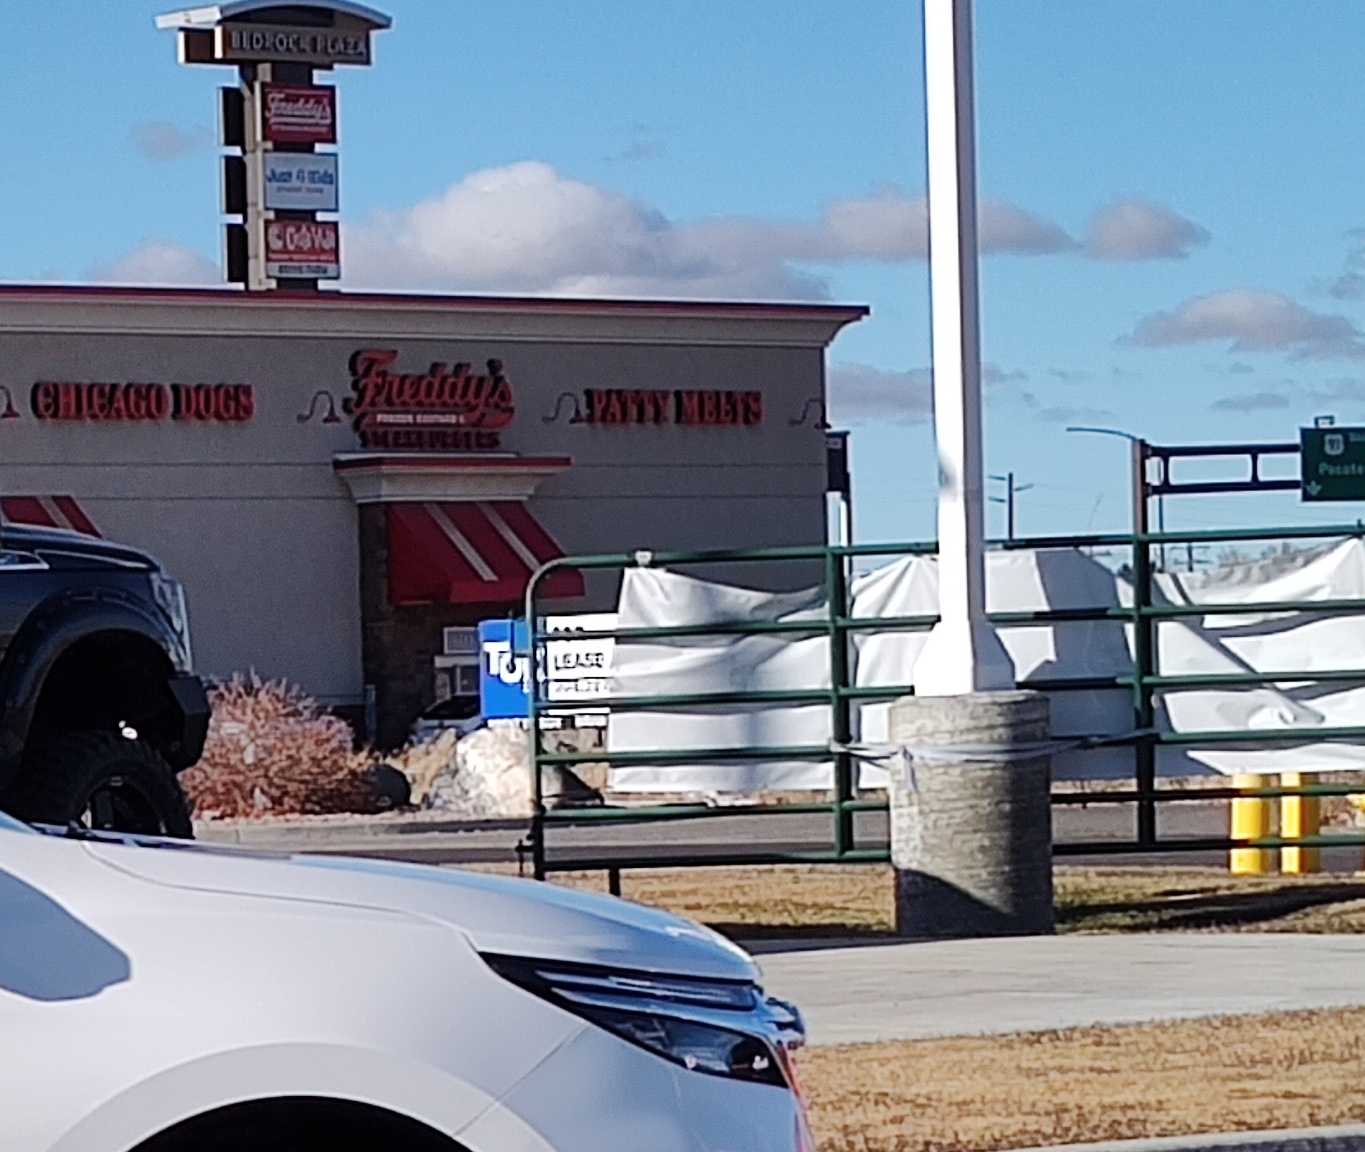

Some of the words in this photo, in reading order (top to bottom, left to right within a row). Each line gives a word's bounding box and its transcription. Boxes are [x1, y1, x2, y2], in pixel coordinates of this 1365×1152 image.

[316, 34, 366, 55] PLAZA
[31, 382, 170, 421] CHICAGO
[171, 383, 255, 421] DOGS
[342, 348, 515, 430] Freddy's
[584, 388, 671, 425] PATTY
